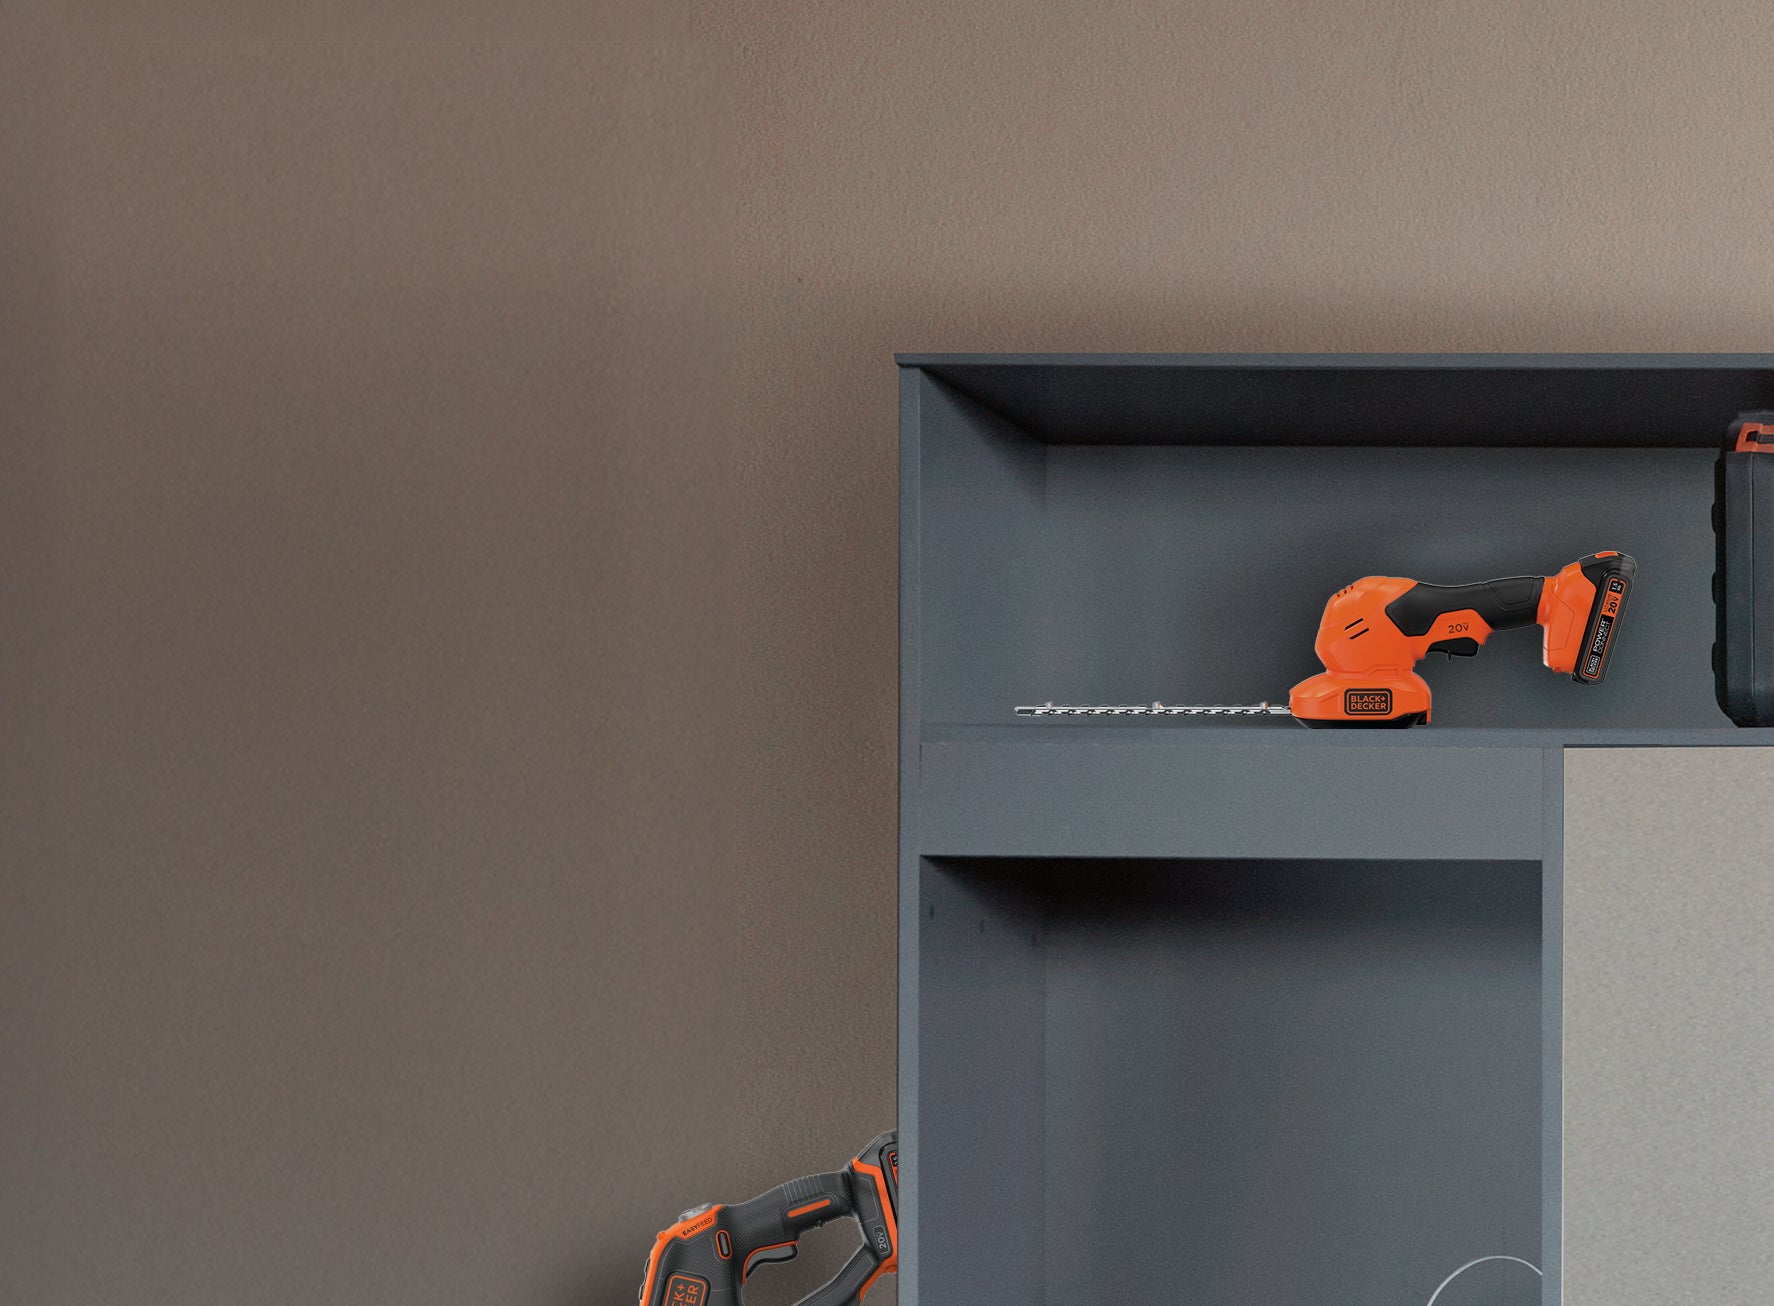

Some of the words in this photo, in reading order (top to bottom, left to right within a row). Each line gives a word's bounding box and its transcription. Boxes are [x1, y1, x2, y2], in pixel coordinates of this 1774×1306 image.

[1593, 619, 1608, 652] POWER
[1350, 695, 1386, 703] BLACK+
[1350, 702, 1387, 710] DECKER
[682, 1217, 713, 1236] EASYFEED
